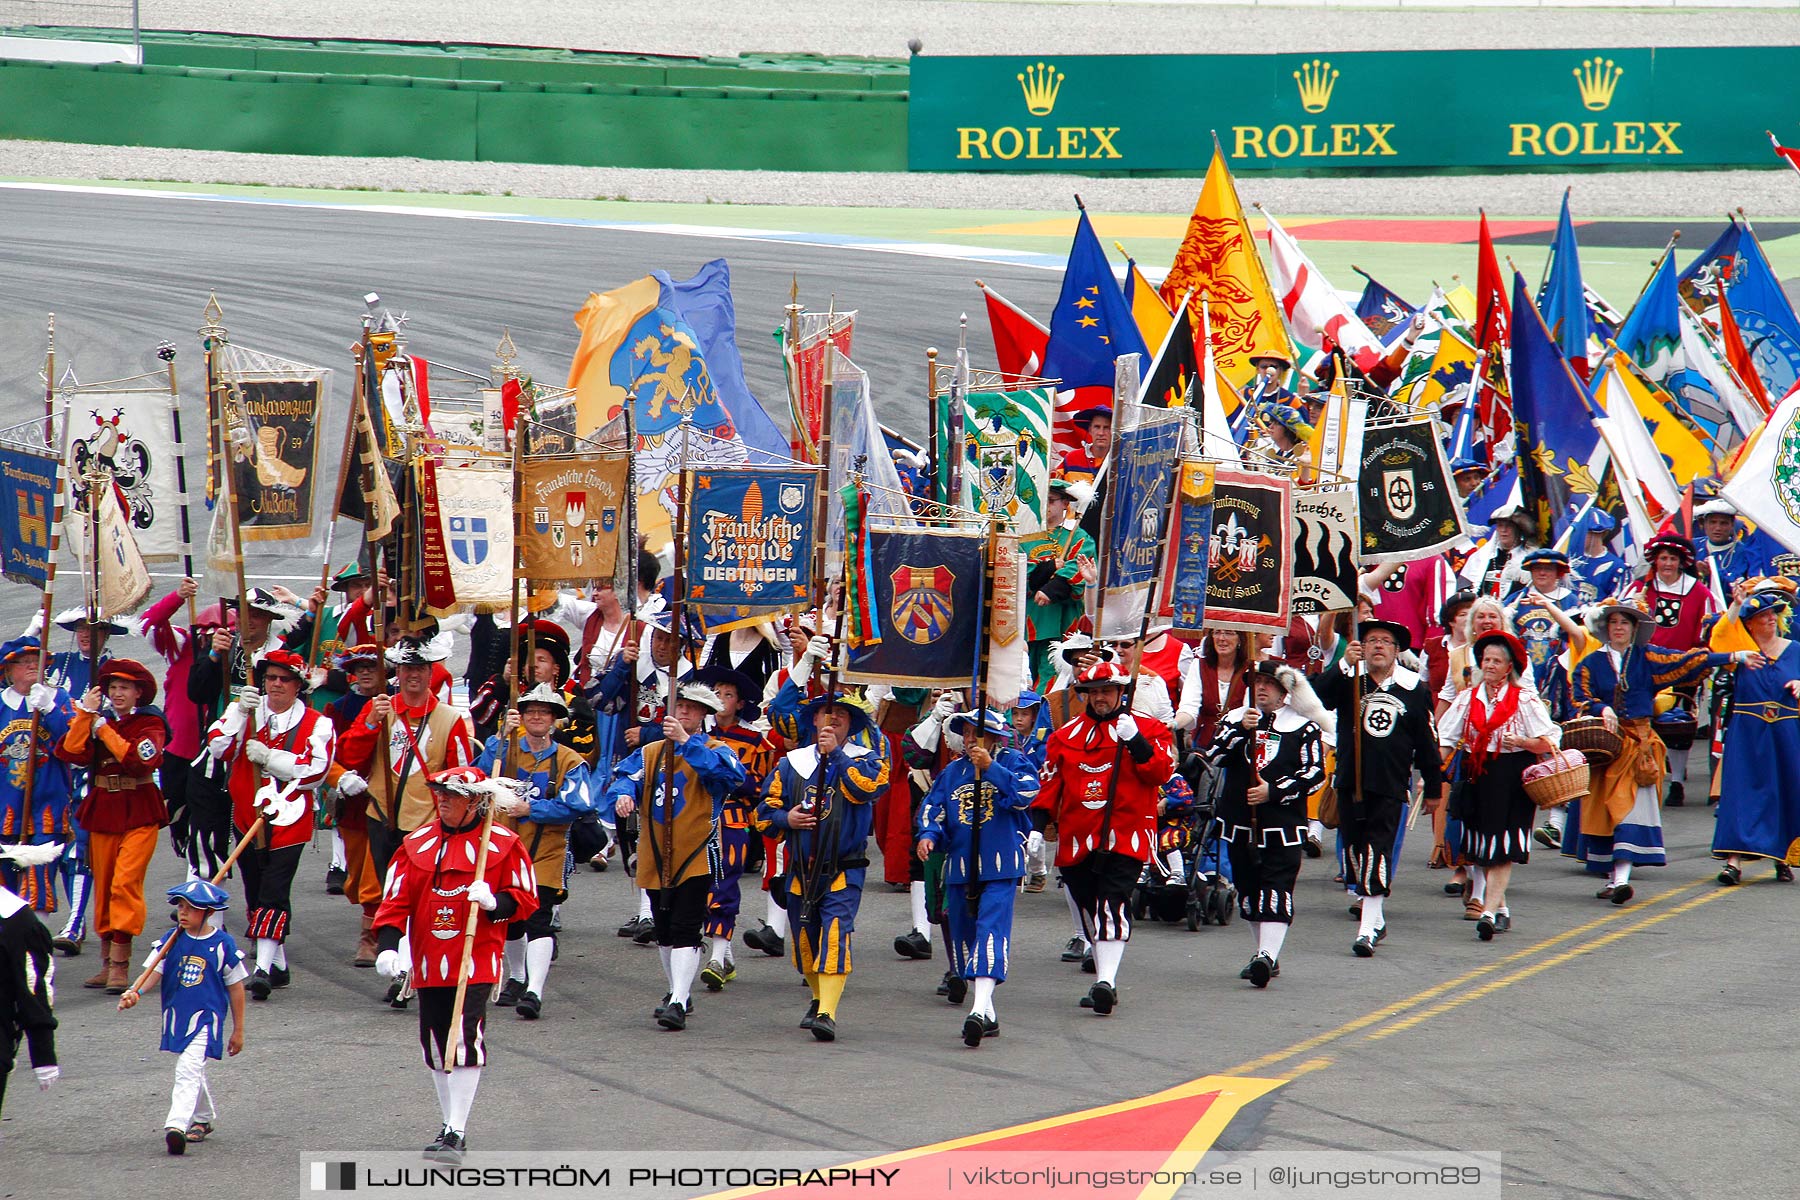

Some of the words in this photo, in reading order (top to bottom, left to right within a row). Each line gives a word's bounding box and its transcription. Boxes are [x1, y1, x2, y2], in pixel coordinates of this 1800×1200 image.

[956, 126, 1122, 160] ROLEX
[1231, 124, 1397, 158] ROLEX
[1508, 122, 1683, 156] ROLEX
[1213, 495, 1261, 520] anfarenzug
[703, 538, 794, 565] Herolde
[1262, 557, 1275, 569] 53
[703, 566, 797, 582] DERTINGEN
[739, 582, 764, 592] 1956
[1206, 583, 1262, 599] sdorf/Saar
